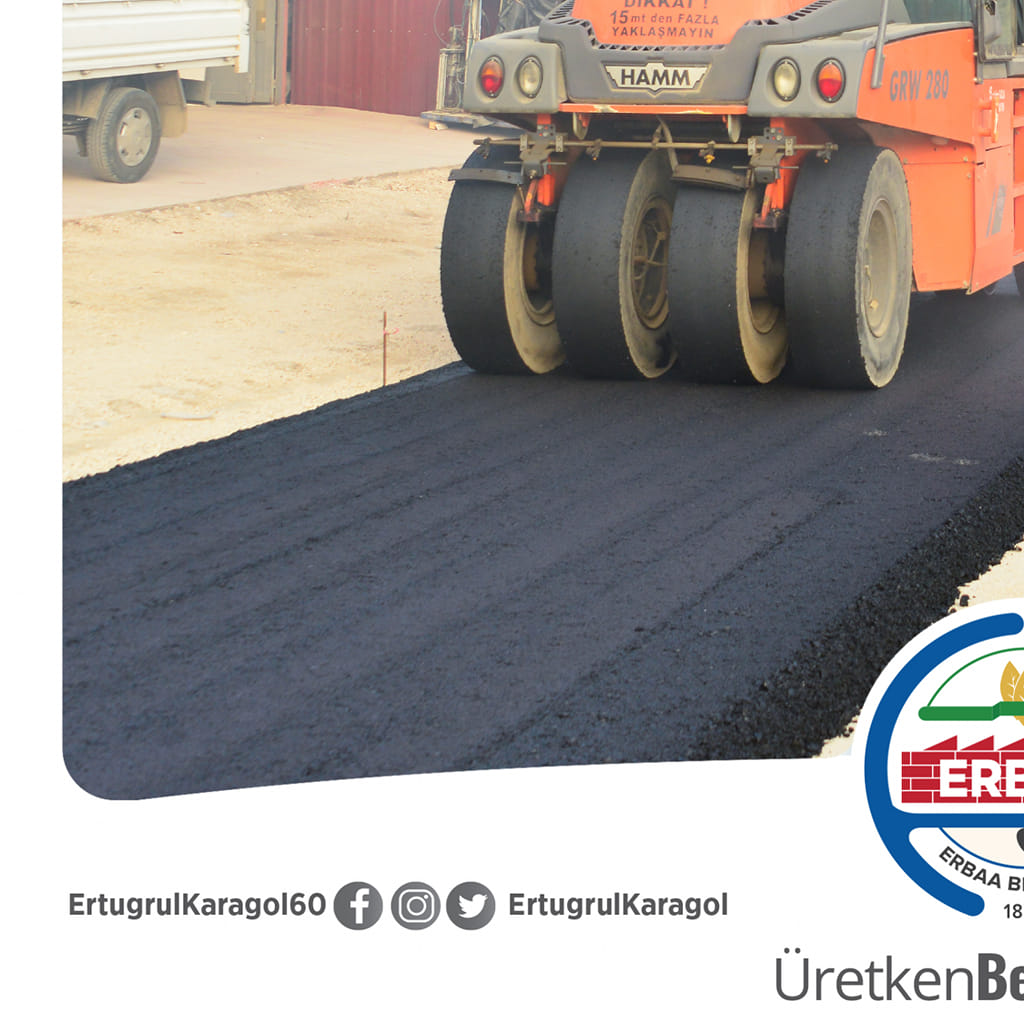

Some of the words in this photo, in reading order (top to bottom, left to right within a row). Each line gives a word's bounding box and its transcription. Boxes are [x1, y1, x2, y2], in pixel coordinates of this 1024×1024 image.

[650, 13, 673, 24] den
[677, 13, 719, 25] FAZLA
[612, 26, 714, 39] YAKLAŞMAYIN
[620, 68, 691, 86] HAMM
[889, 69, 922, 102] GRW
[926, 68, 949, 100] 280
